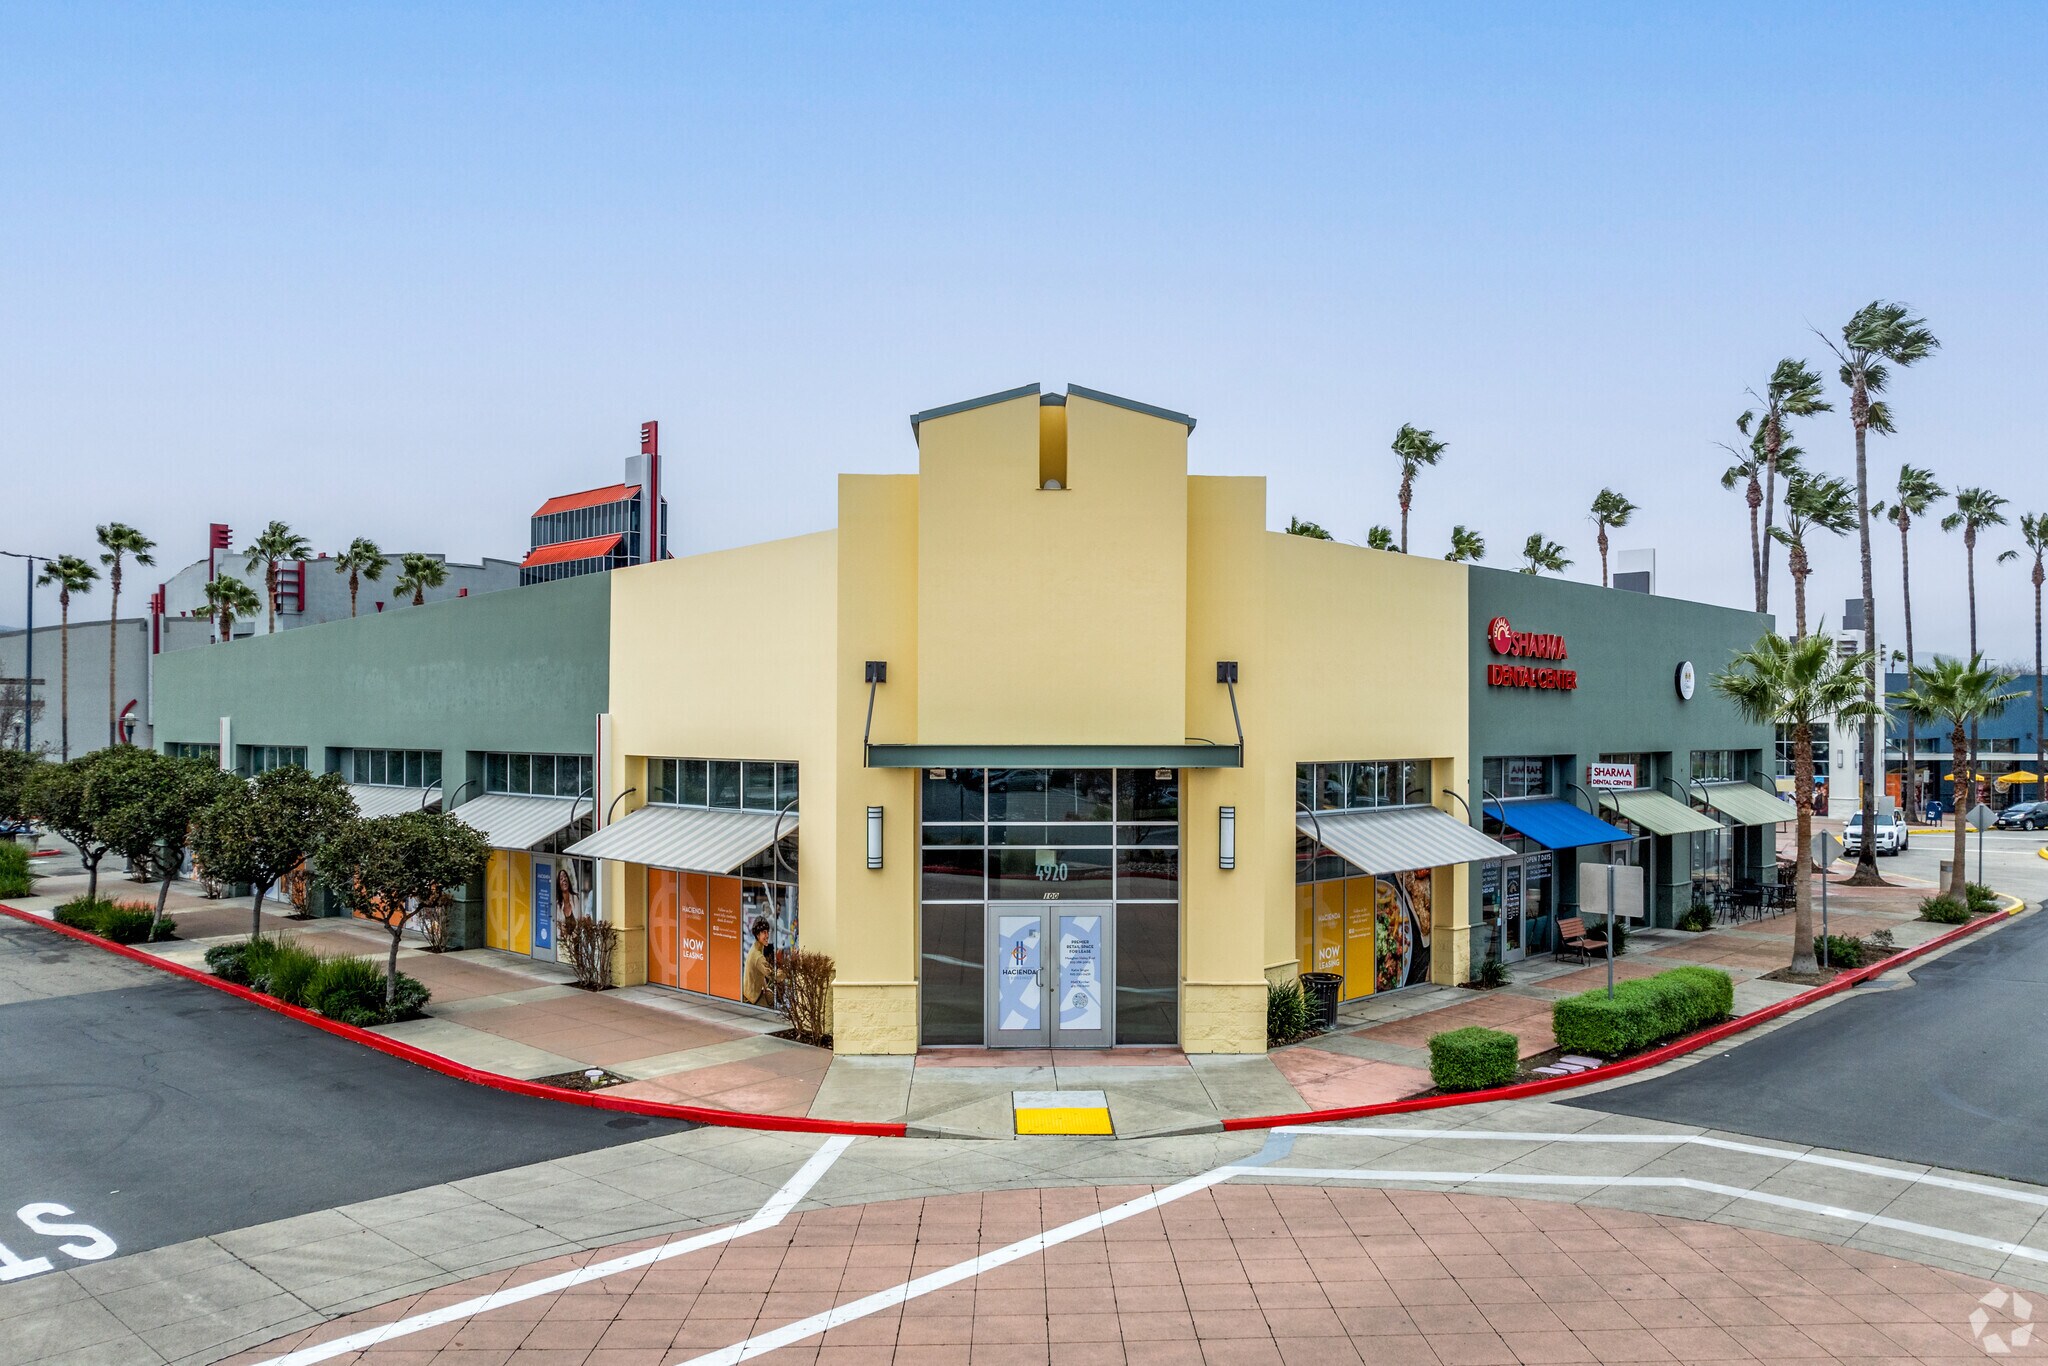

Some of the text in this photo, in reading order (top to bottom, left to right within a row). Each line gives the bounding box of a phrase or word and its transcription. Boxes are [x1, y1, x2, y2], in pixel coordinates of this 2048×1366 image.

[1510, 632, 1568, 659] SHARMA
[1489, 664, 1578, 689] DENTAL CENTER
[1593, 767, 1632, 777] SHARMA
[1526, 855, 1538, 863] OPEN
[1541, 853, 1552, 861] DAYS
[1035, 863, 1068, 881] 4920
[1043, 892, 1060, 900] 100
[681, 905, 704, 915] HACIENDA
[1318, 912, 1341, 921] HACIENDA
[683, 938, 704, 950] NOW
[683, 950, 704, 960] LEASING
[1318, 945, 1341, 960] NOW
[1318, 958, 1341, 969] LEASING
[1003, 968, 1037, 976] HACIENDA
